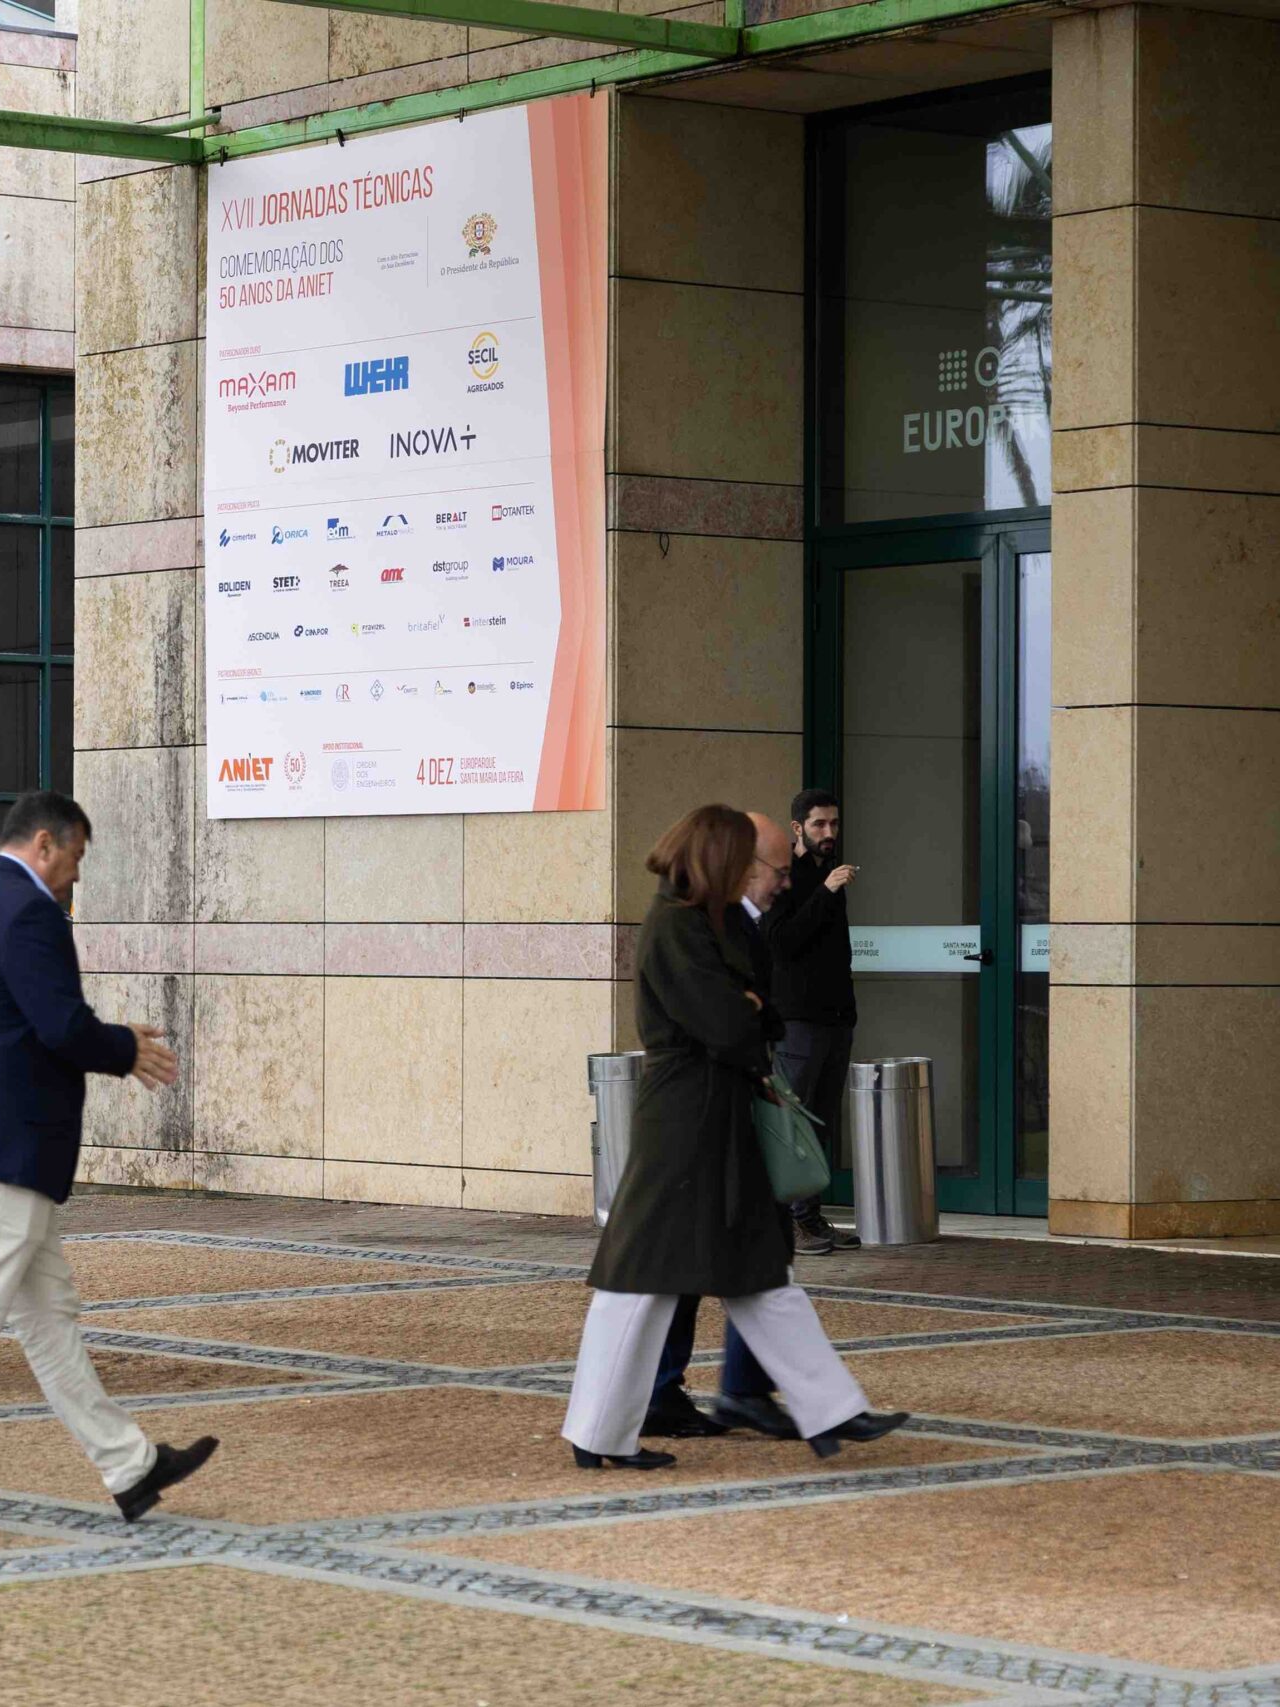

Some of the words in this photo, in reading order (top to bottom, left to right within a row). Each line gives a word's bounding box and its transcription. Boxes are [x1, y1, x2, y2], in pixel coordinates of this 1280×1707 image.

[221, 196, 254, 233] XVII
[259, 181, 348, 226] JORNADAS
[353, 165, 434, 210] TÉCNICAS
[220, 241, 317, 279] COMEMORAÇÃO
[320, 239, 344, 264] DOS
[440, 267, 446, 276] O
[446, 262, 478, 275] Presidente
[479, 261, 487, 270] da
[488, 256, 520, 269] República
[220, 285, 235, 309] 50
[239, 280, 273, 307] ANOS
[276, 278, 294, 301] DA
[297, 272, 335, 298] ANIET
[468, 347, 499, 365] SECIL
[344, 356, 409, 396] WEIR
[467, 381, 504, 393] AGREGADOS
[228, 402, 249, 413] Beyond
[250, 400, 287, 410] Performance
[292, 438, 360, 464] MOVITER
[436, 512, 467, 524] BERALT
[284, 529, 308, 539] ORICA
[432, 560, 469, 574] dstgroup
[506, 555, 534, 566] MOURA
[219, 580, 250, 592] BOLIDEN
[273, 576, 295, 588] STET
[329, 579, 349, 588] TREEA
[472, 615, 506, 628] interstein
[247, 631, 280, 642] ASCENDUM
[304, 628, 328, 637] CIMPOR
[516, 681, 534, 690] Epiroc
[219, 756, 274, 782] ANIET
[290, 758, 301, 773] 50
[460, 757, 496, 769] EUROPARQUE
[417, 758, 426, 786] 4
[429, 757, 457, 786] DEZ.
[460, 772, 479, 784] SANTA
[479, 771, 497, 784] MARIA
[498, 771, 507, 783] DA
[507, 770, 524, 783] FEIRA
